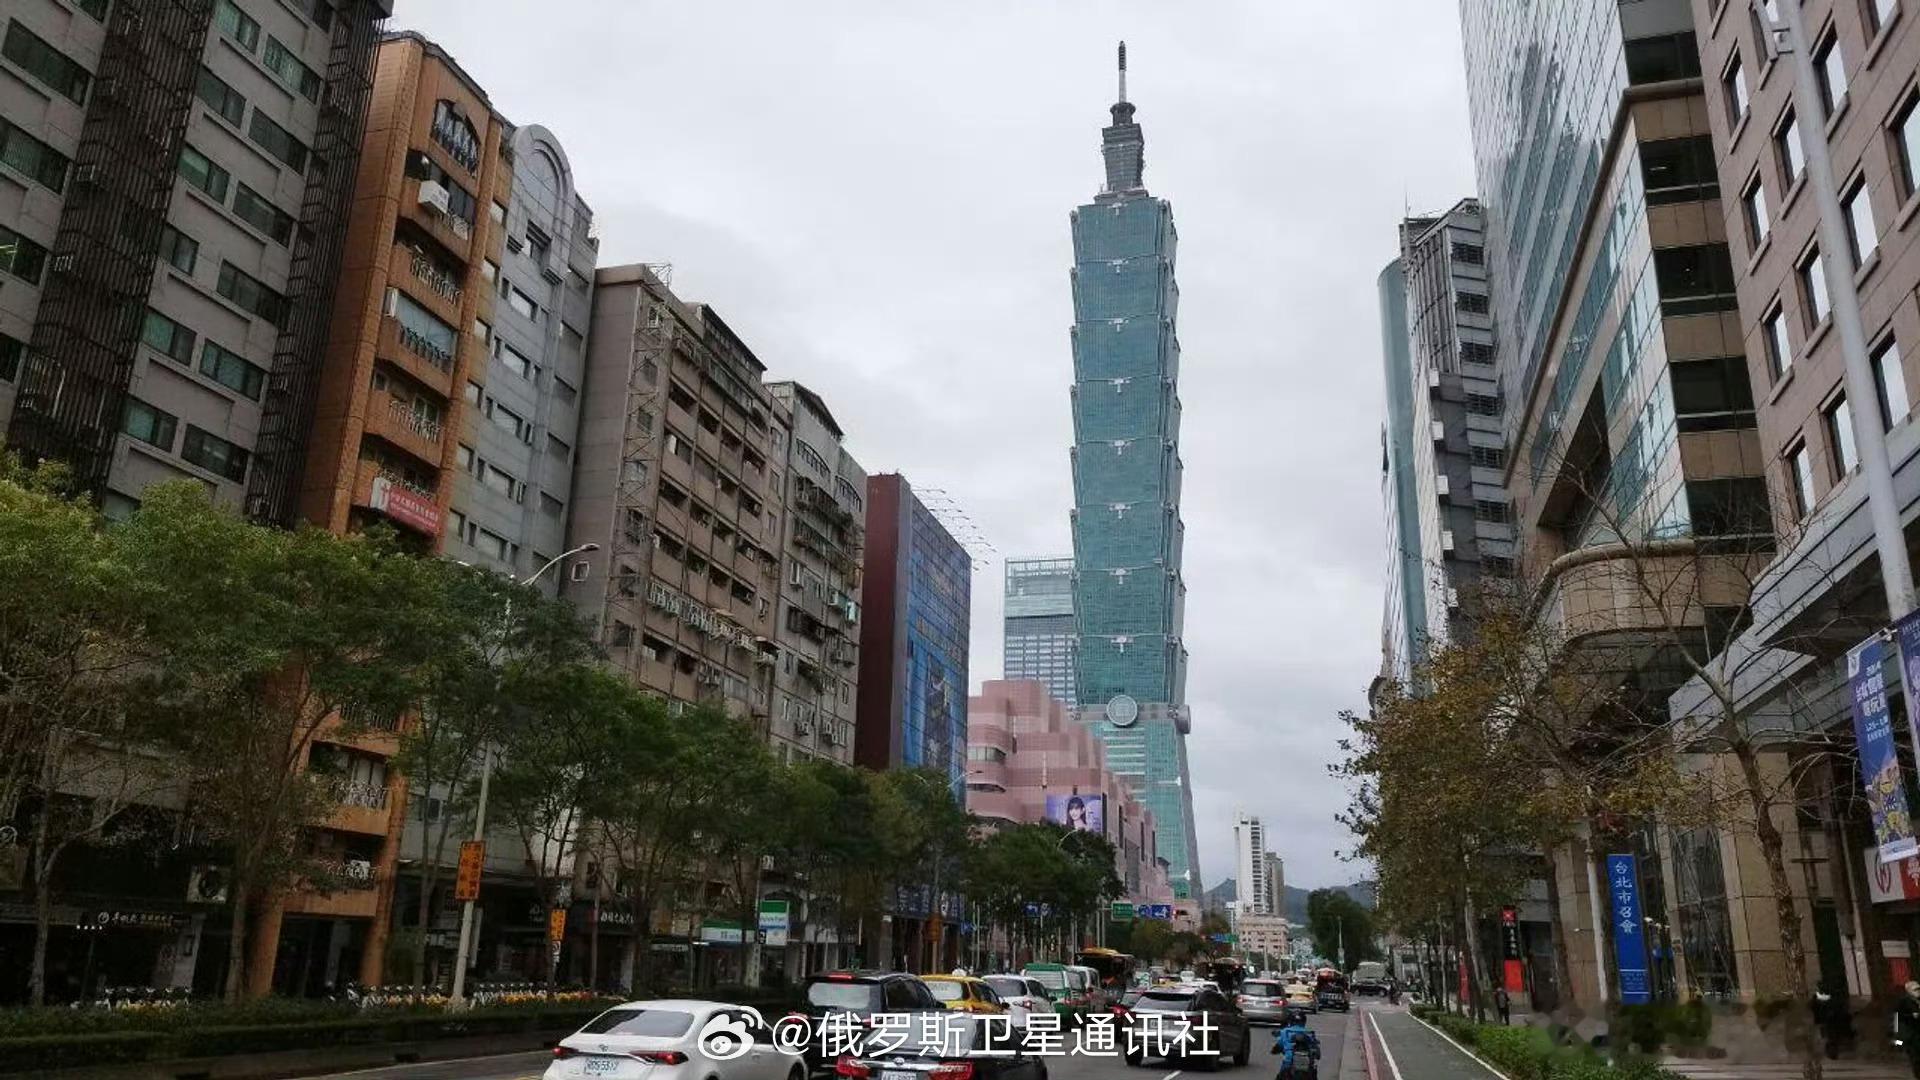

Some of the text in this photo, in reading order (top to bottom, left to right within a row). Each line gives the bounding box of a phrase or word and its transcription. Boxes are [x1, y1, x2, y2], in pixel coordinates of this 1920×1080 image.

[1615, 861, 1638, 935] 台北市召會
